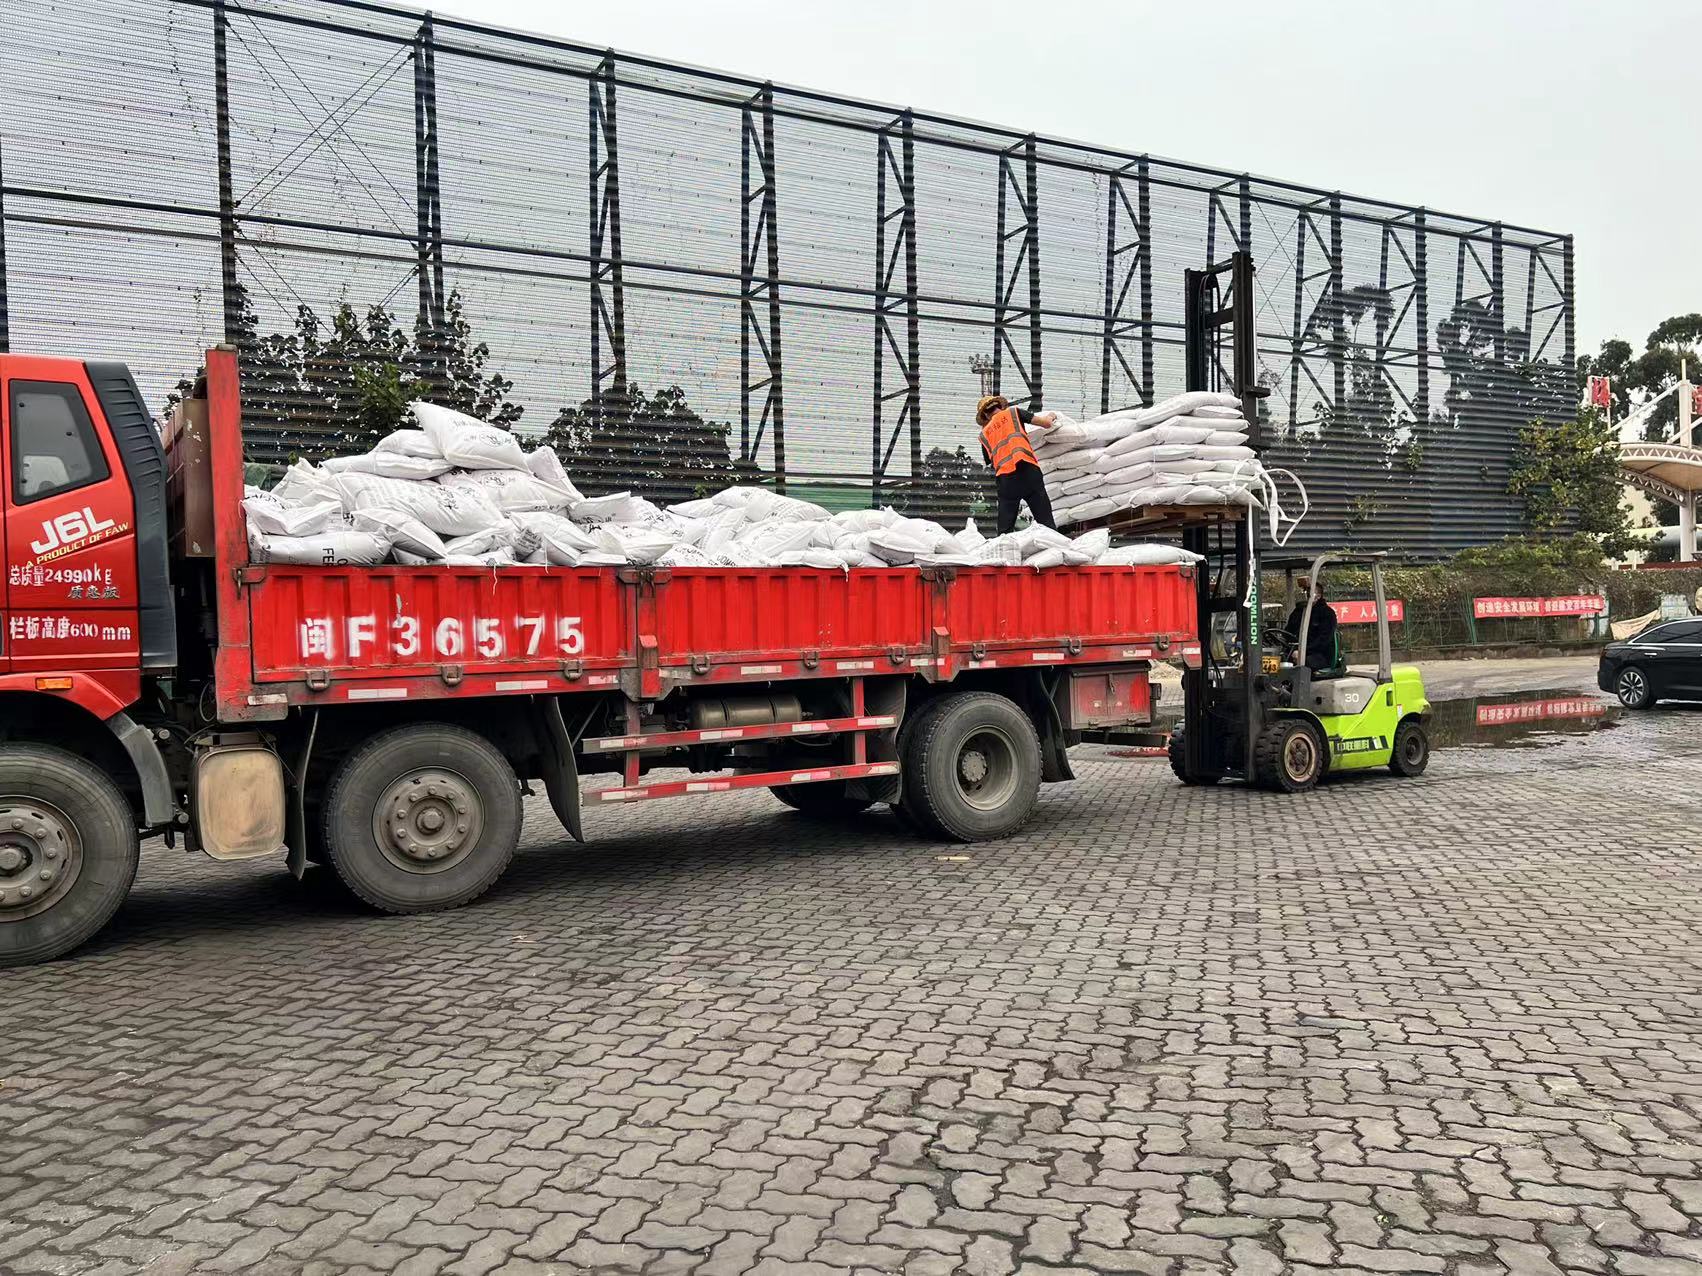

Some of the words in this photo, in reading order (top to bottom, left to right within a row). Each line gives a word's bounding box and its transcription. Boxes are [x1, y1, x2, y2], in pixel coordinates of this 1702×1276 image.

[26, 560, 34, 570] A
[36, 538, 87, 565] PRODUCT
[89, 533, 103, 544] OF
[105, 522, 129, 537] FAW
[30, 506, 115, 555] J6L
[322, 547, 335, 566] FE
[1250, 577, 1258, 645] ZOOMLION
[1344, 692, 1360, 703] 30
